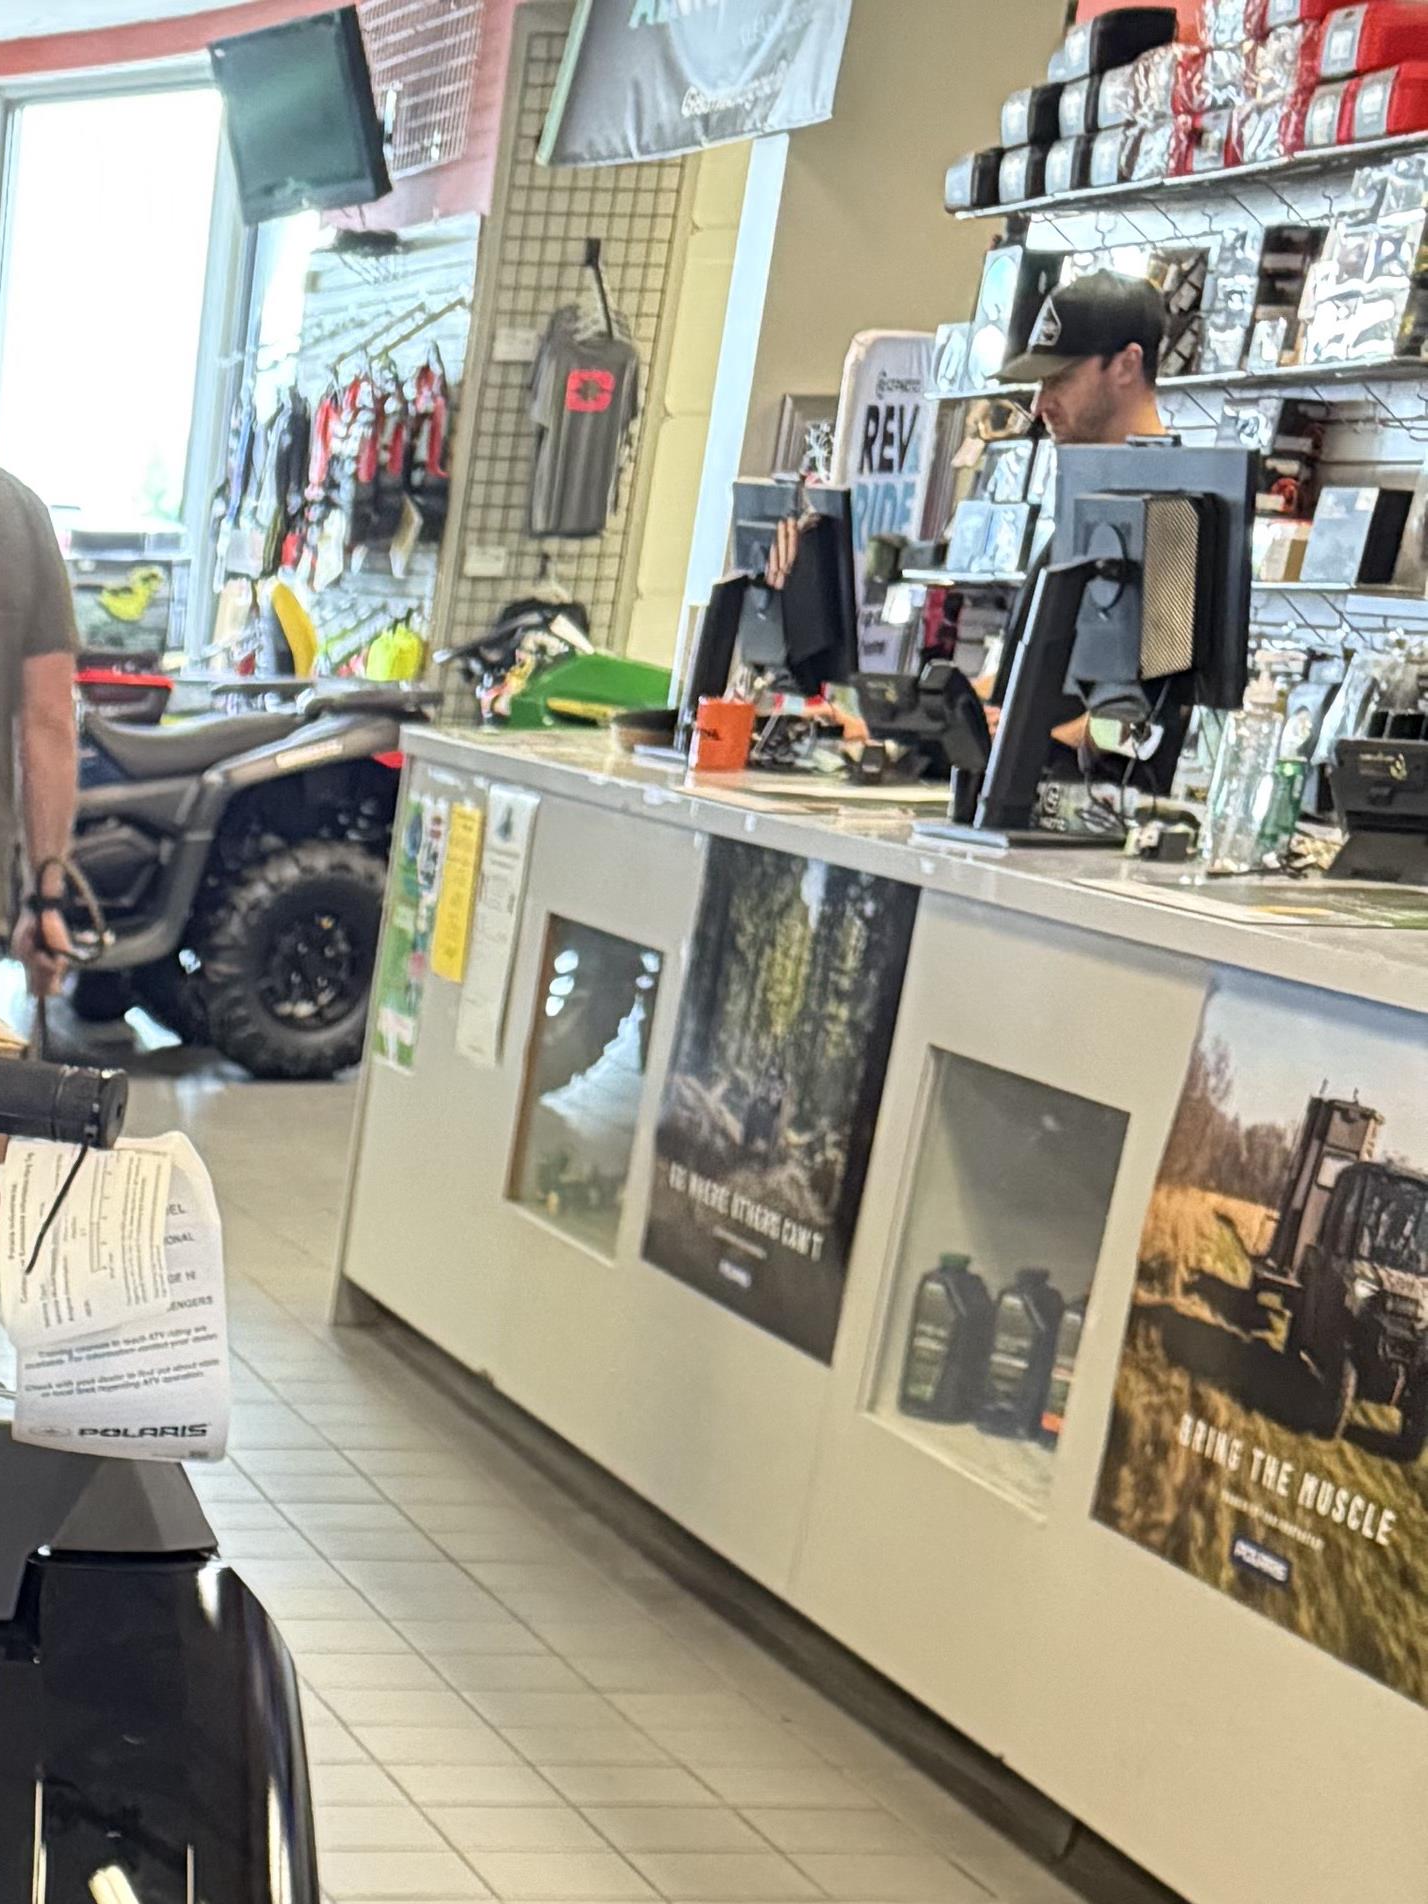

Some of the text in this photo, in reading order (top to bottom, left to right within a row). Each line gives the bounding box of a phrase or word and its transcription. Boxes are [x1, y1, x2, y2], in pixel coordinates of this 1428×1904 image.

[858, 404, 920, 475] REV
[730, 1191, 782, 1240] OTHERS
[781, 1217, 825, 1262] CAN'T
[78, 1423, 209, 1439] POLARIS
[1179, 1412, 1244, 1472] BRING
[1250, 1447, 1294, 1498] THE
[1298, 1471, 1397, 1547] MUSCLE
